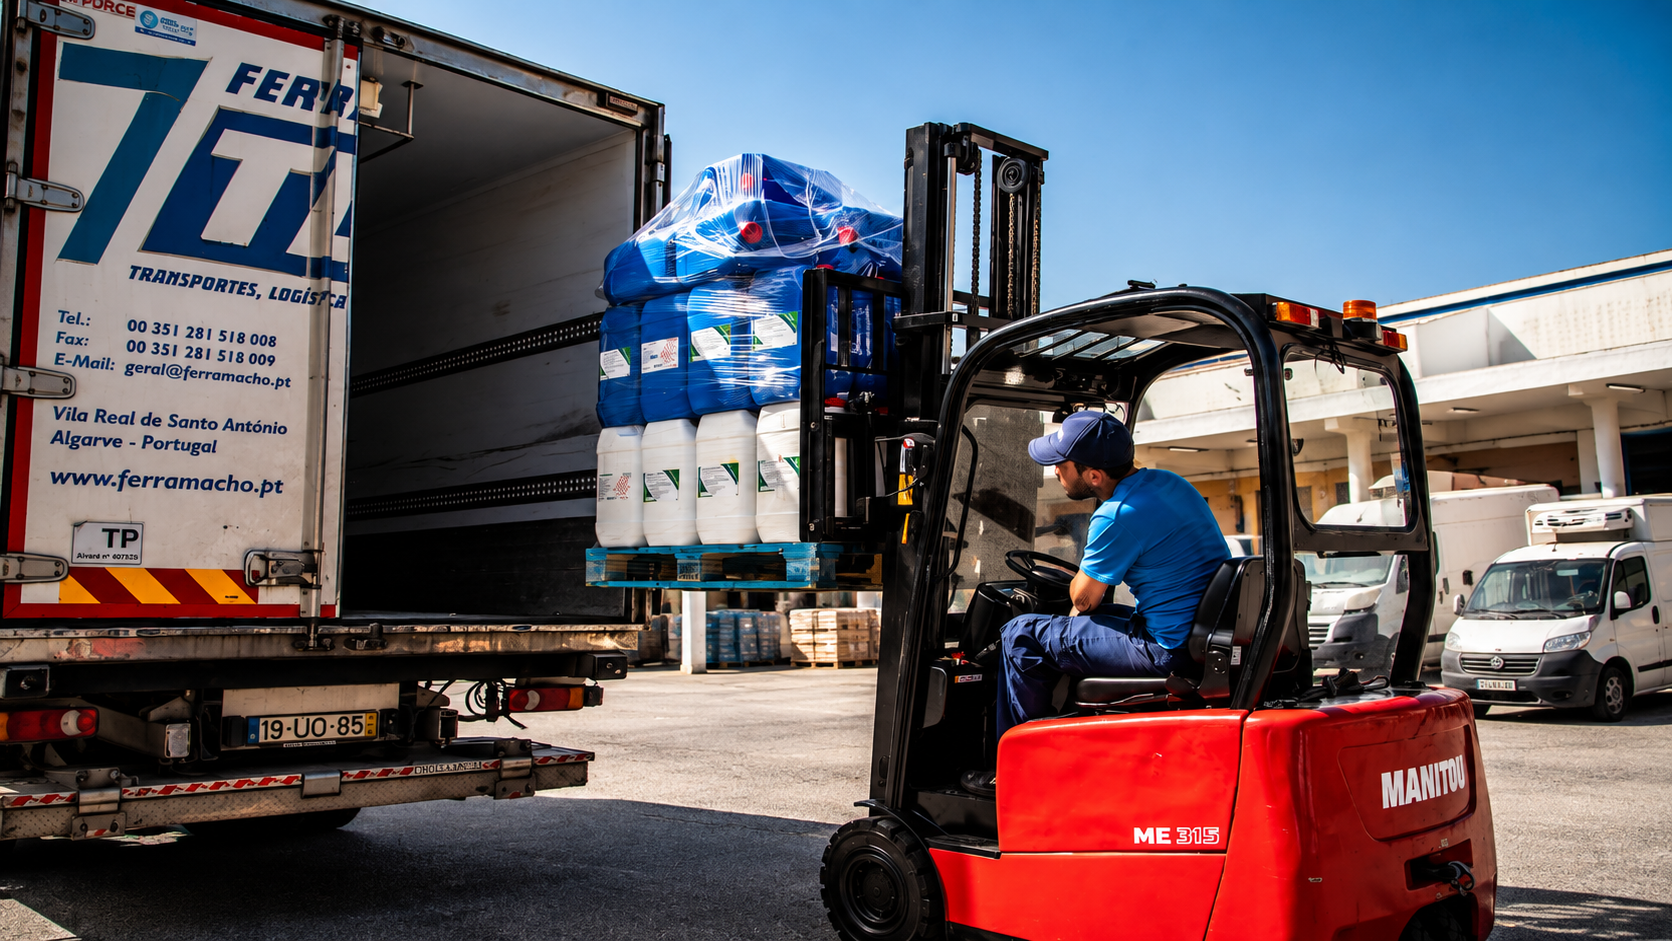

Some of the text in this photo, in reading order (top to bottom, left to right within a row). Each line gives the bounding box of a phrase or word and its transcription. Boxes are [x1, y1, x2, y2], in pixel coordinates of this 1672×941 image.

[225, 62, 358, 120] FERR
[129, 265, 262, 300] TRANSPORTES,
[58, 310, 277, 348] Tel.: 00 351 281 518 008
[55, 331, 276, 367] Fax: 00 351 281 518 009
[54, 352, 291, 389] E-Mail: geral@ferramacho.pt
[53, 406, 288, 435] Vila Real de Santo António
[50, 429, 123, 450] Algarve
[141, 435, 217, 456] Portugal
[50, 468, 284, 498] www.ferramacho.pt
[102, 528, 139, 548] TP
[1381, 754, 1465, 809] MANITOU
[1133, 826, 1220, 845] ME 315
